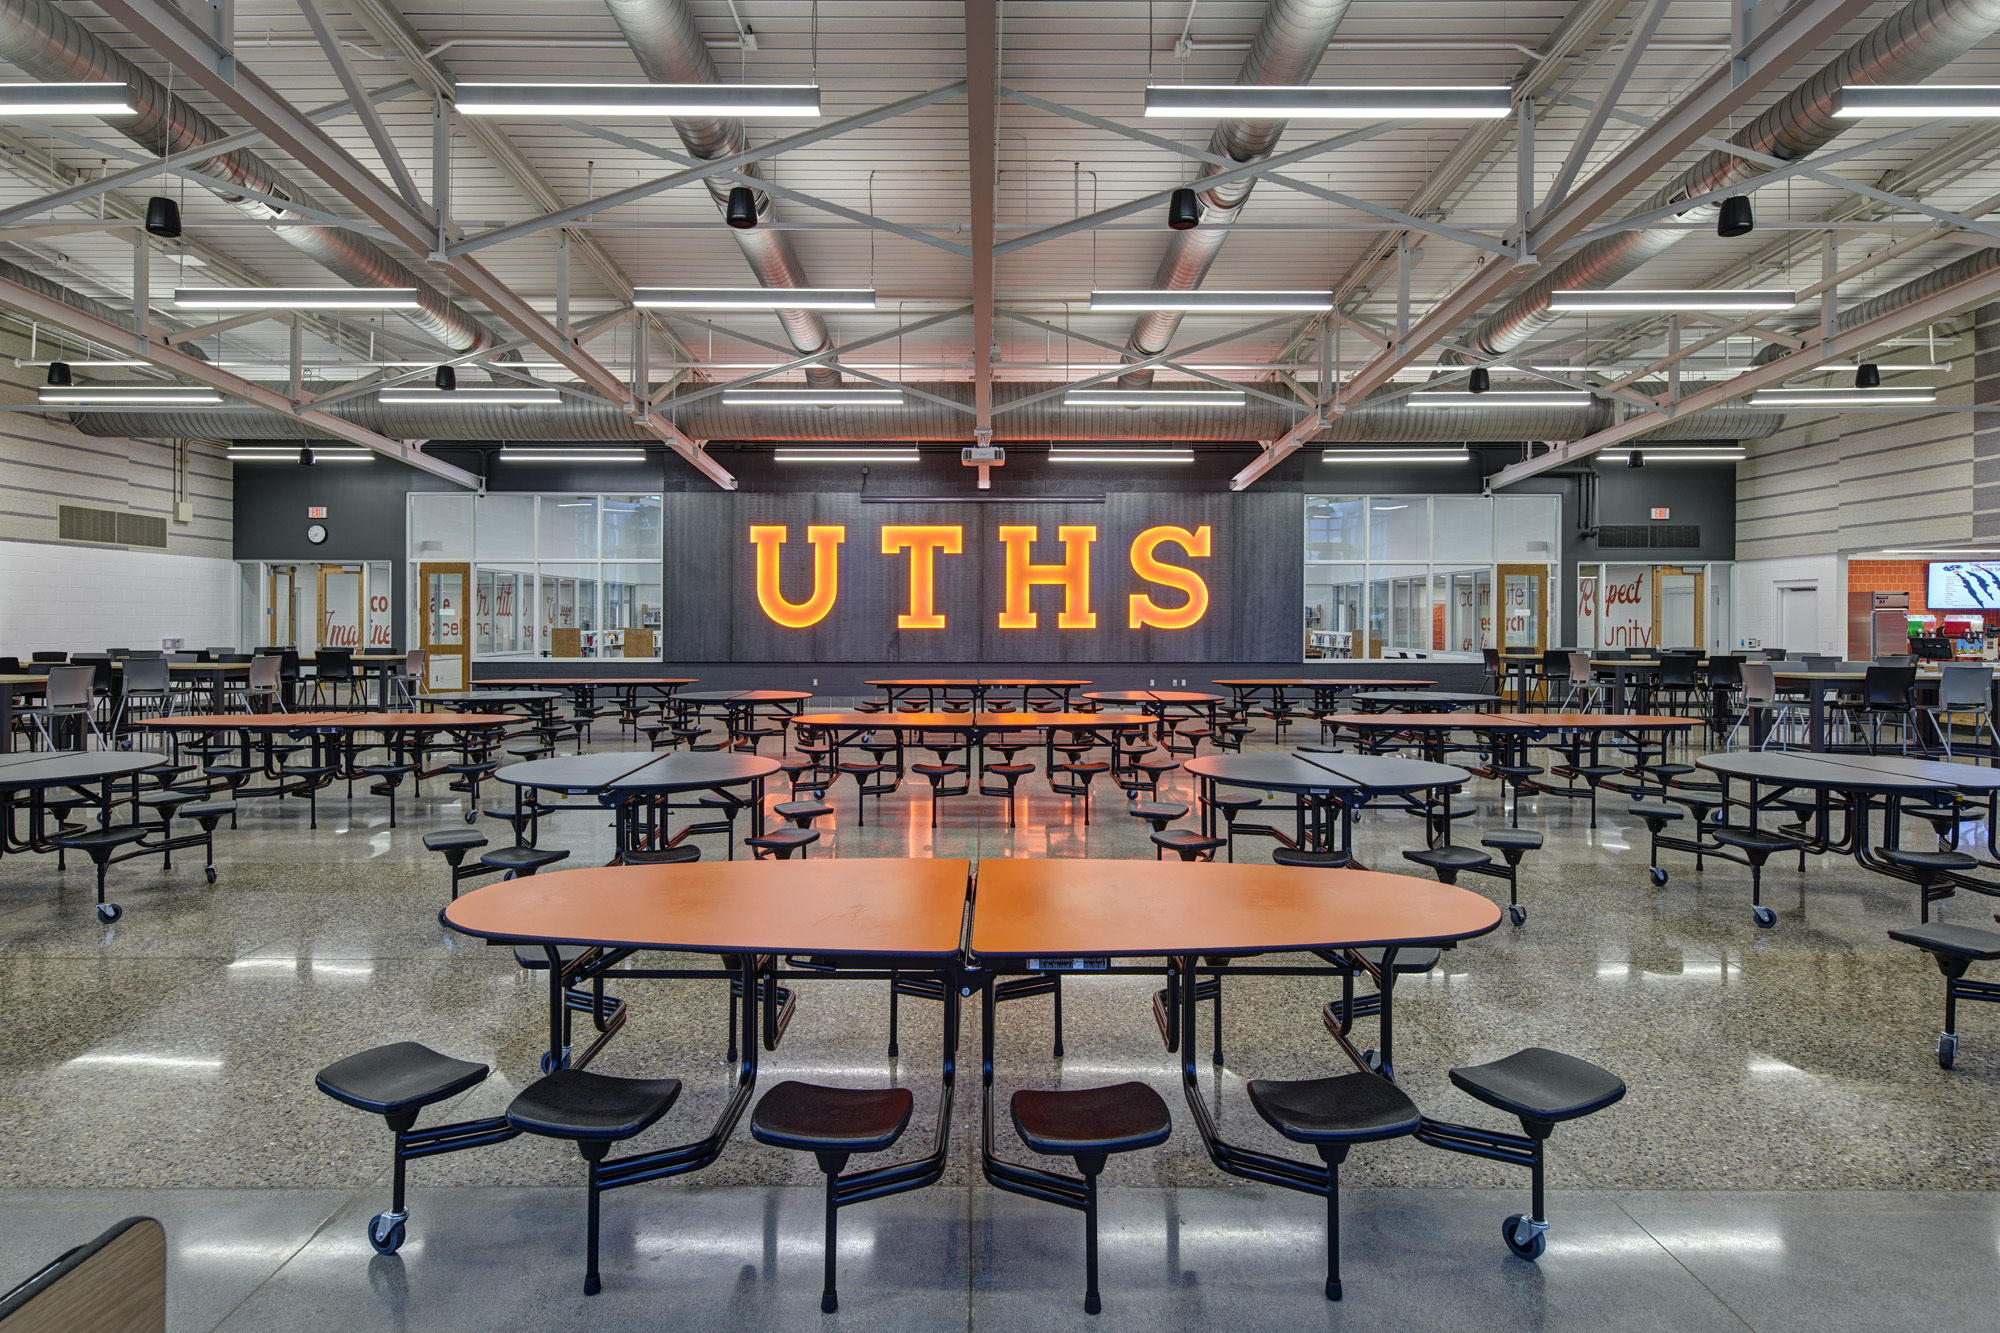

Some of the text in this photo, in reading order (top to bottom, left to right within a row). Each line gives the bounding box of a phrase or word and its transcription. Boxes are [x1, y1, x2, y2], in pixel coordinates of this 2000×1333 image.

[311, 507, 324, 518] EXIT
[1655, 508, 1667, 519] EXIT
[749, 525, 1211, 629] UTHS
[326, 610, 390, 647] Imaine
